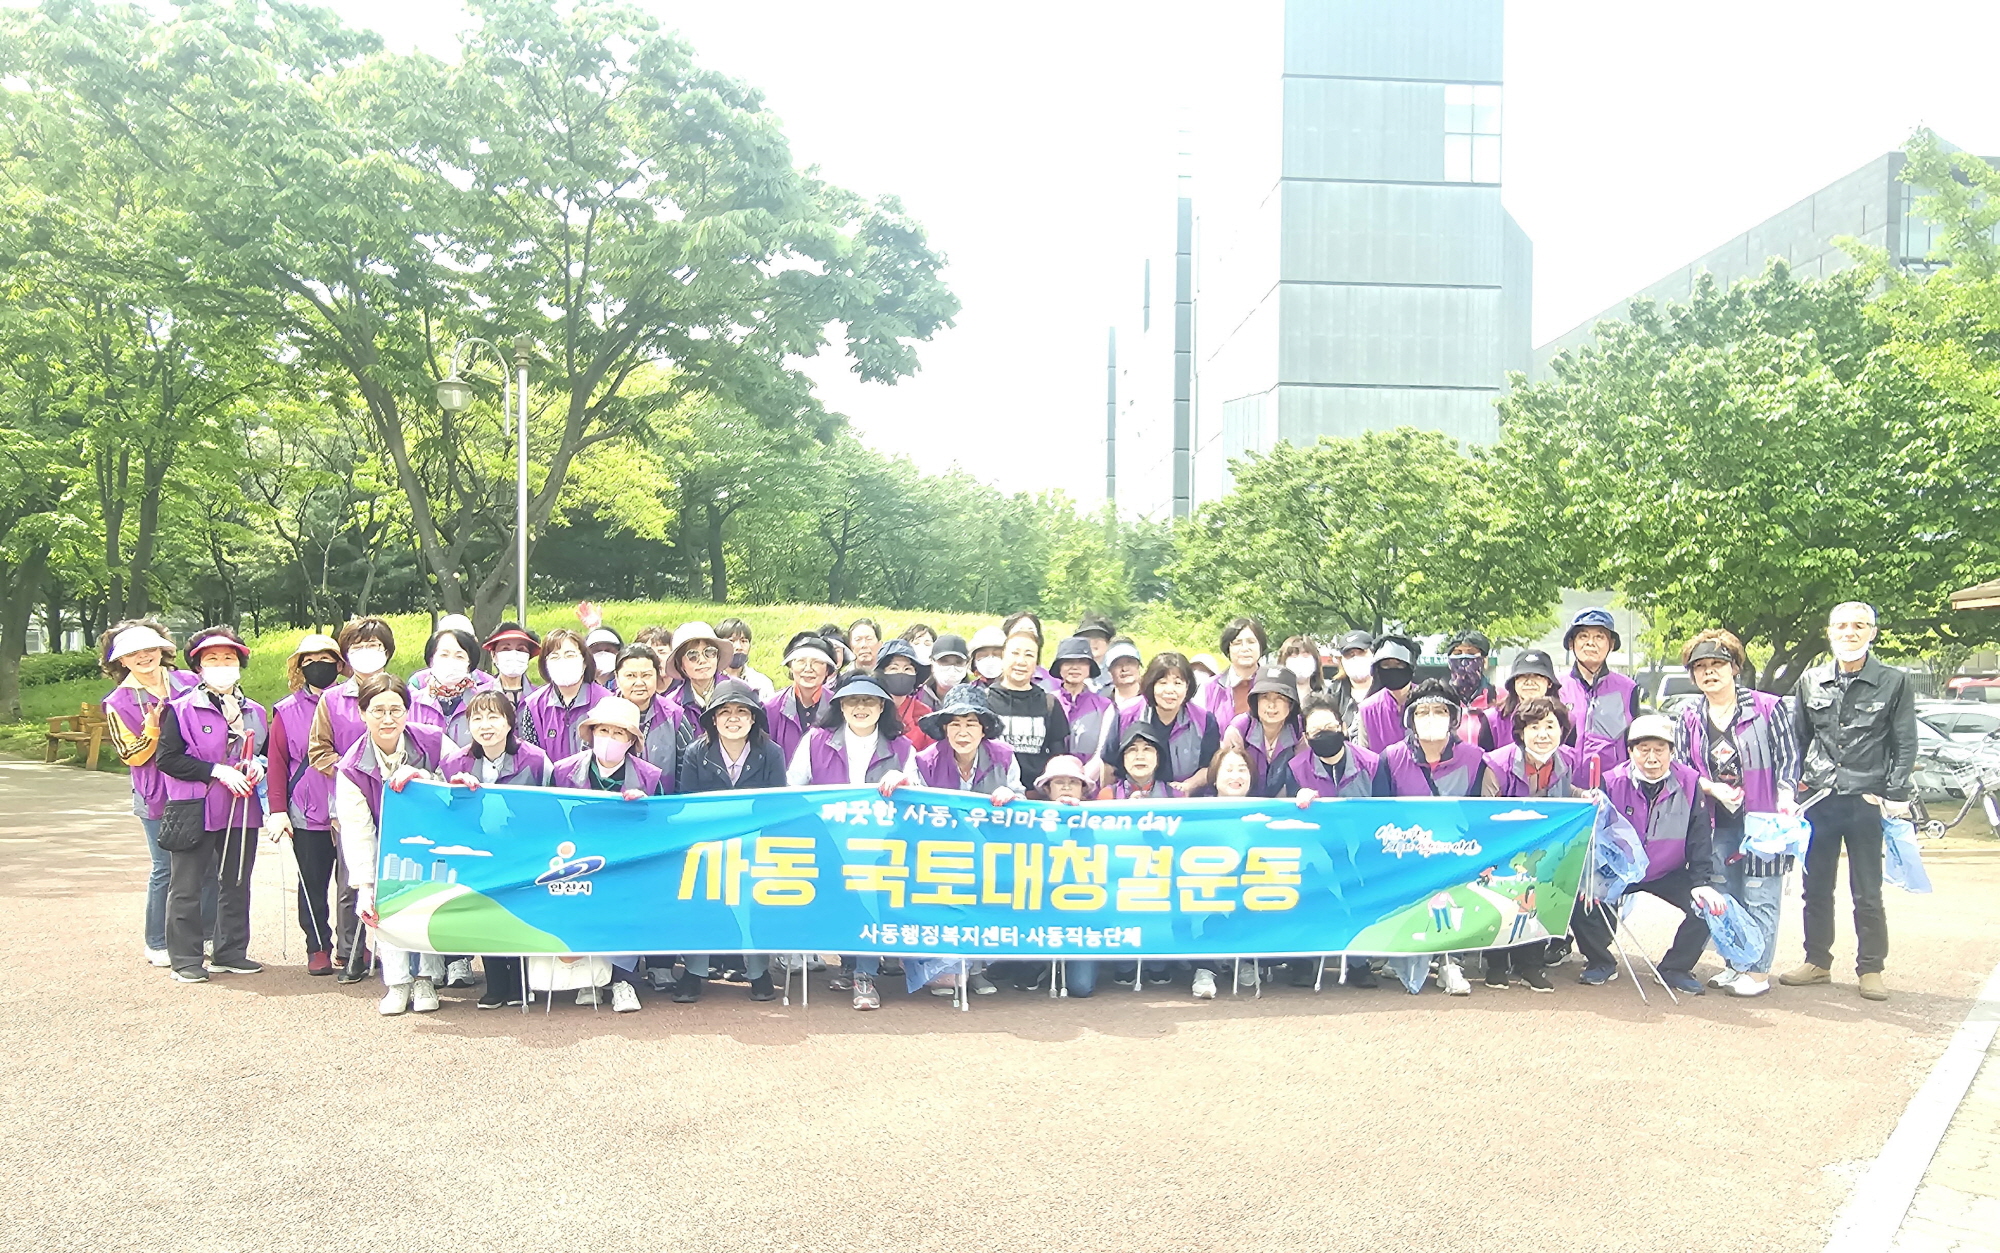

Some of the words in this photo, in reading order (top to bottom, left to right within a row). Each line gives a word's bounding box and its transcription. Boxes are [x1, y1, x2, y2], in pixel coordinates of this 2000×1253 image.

[903, 803, 958, 829] 사동,
[964, 807, 1061, 832] 우리마을
[1067, 810, 1132, 831] clean
[1137, 811, 1182, 836] day
[549, 882, 591, 894] 안산시
[677, 836, 819, 906] 사동
[841, 838, 1302, 912] 국토대청결운동
